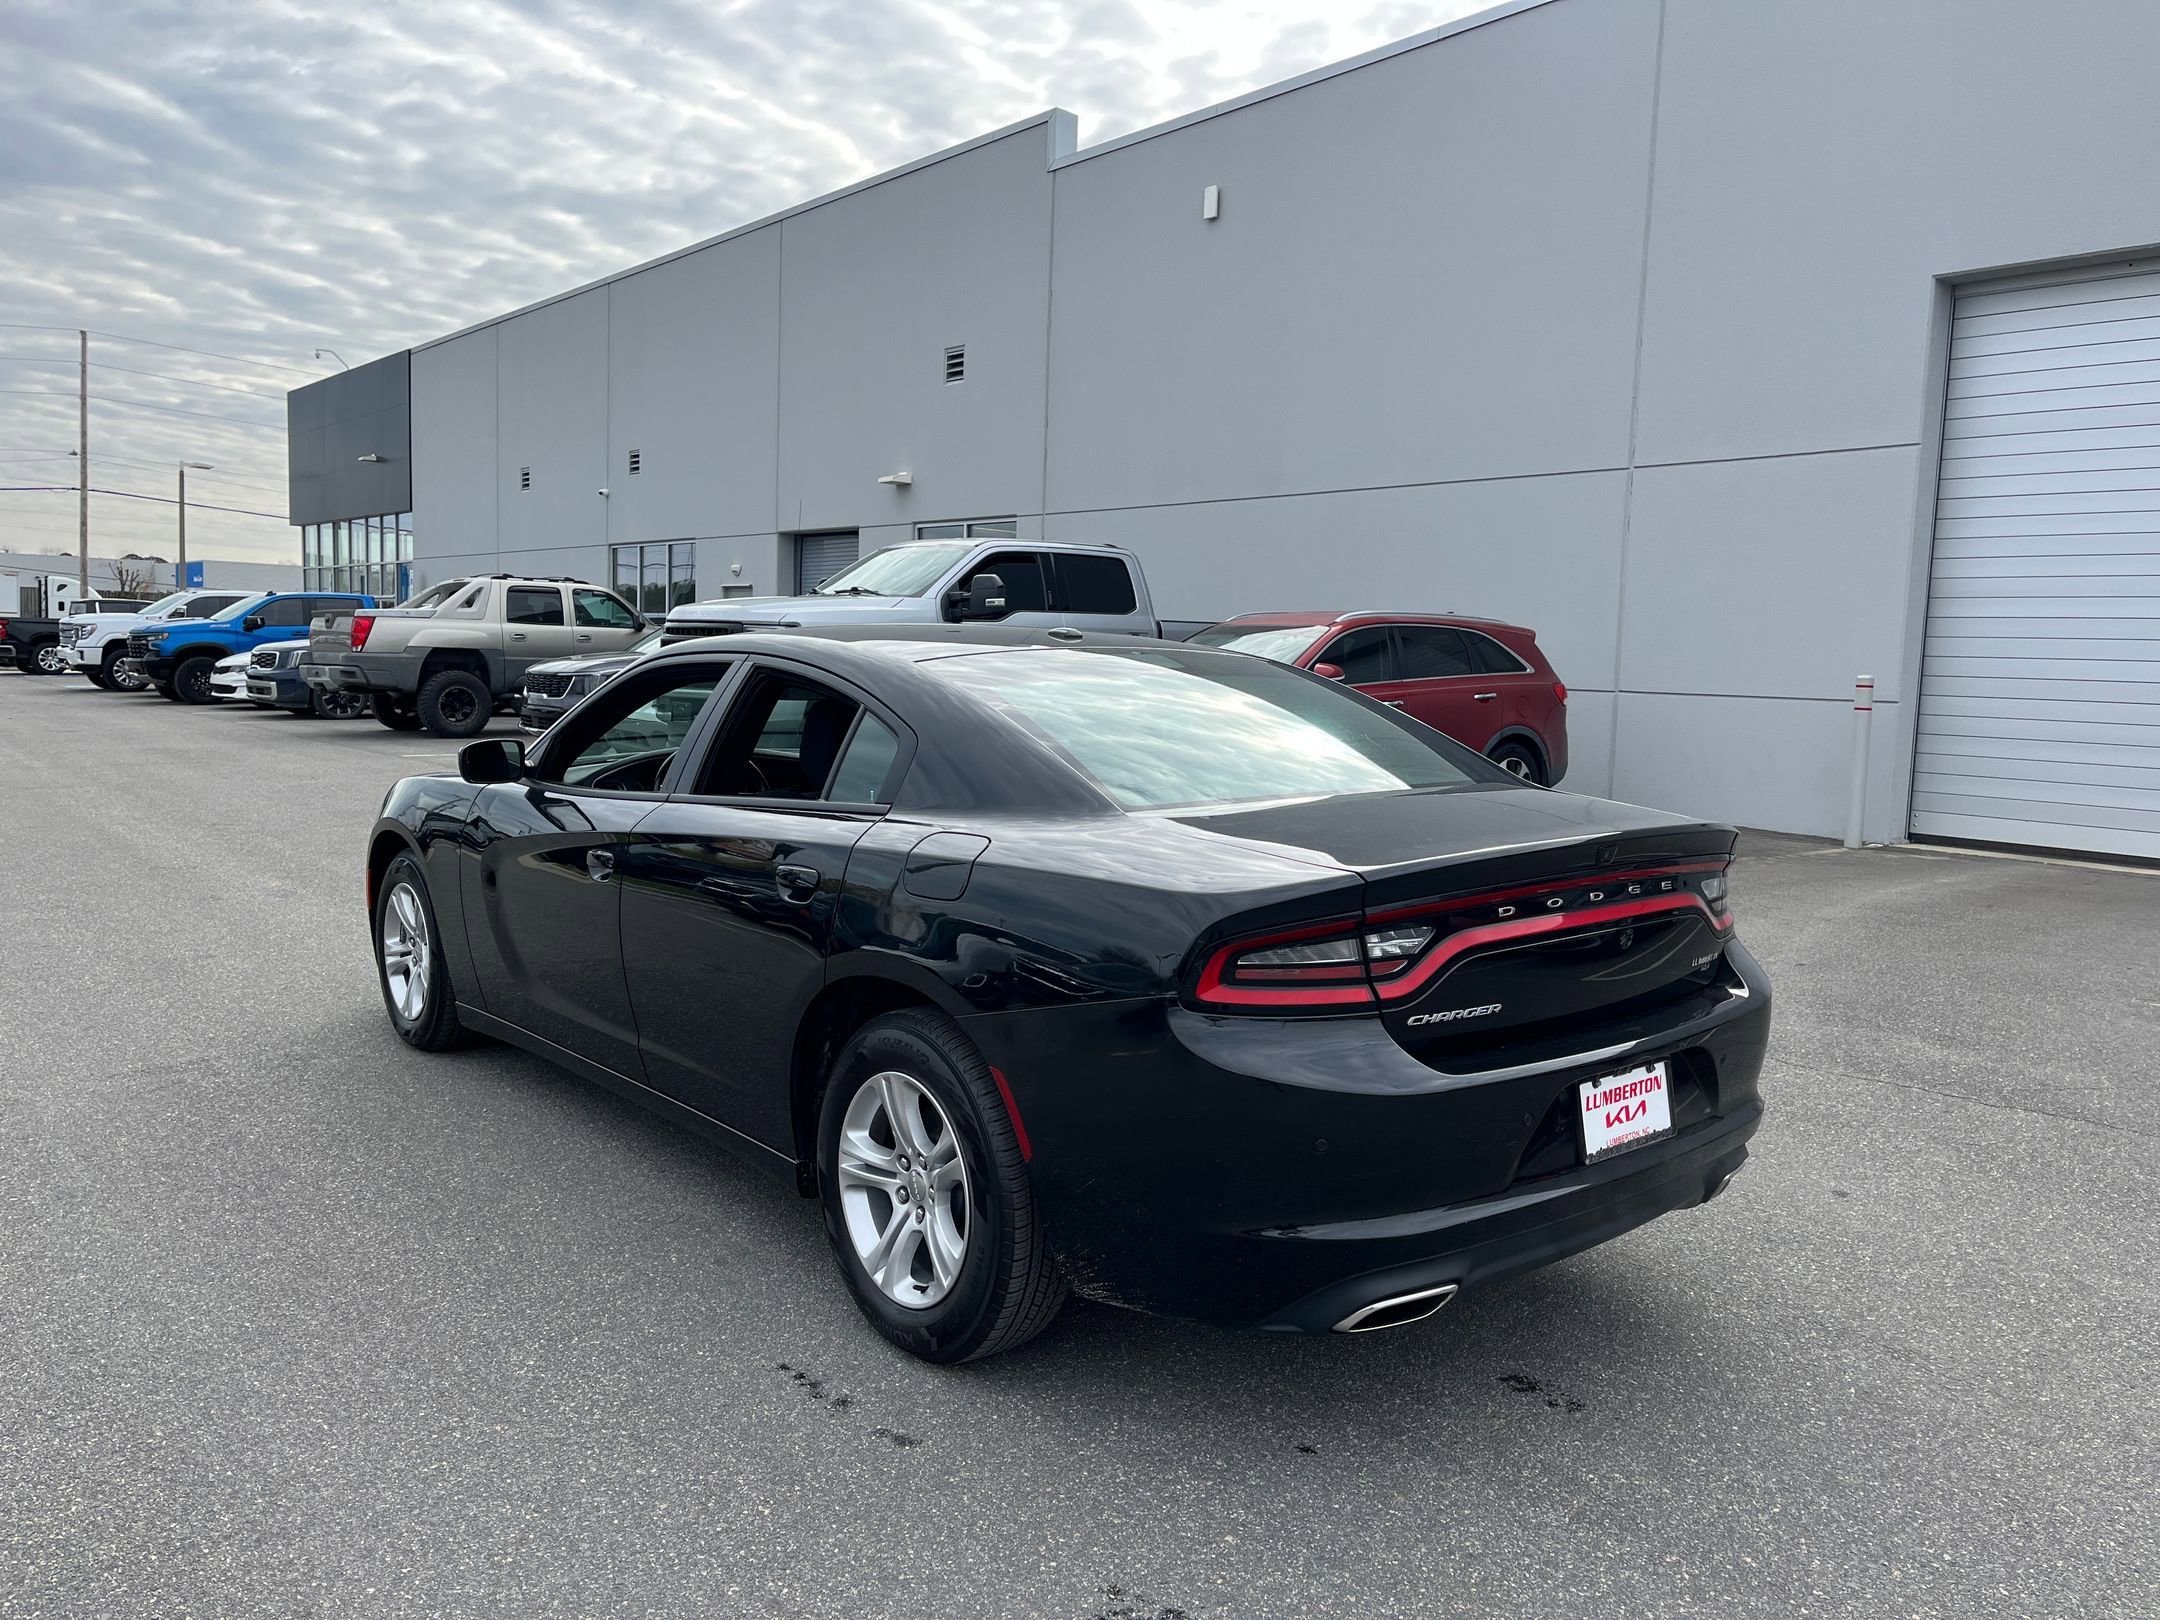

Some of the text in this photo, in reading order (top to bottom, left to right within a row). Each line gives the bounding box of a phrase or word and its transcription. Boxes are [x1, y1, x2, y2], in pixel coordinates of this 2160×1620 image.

[1498, 880, 1672, 917] DODGE
[1407, 1003, 1503, 1026] CHARGER
[1585, 1074, 1662, 1112] LUMBERTON
[1605, 1100, 1647, 1128] KIA
[1642, 1127, 1651, 1137] NC
